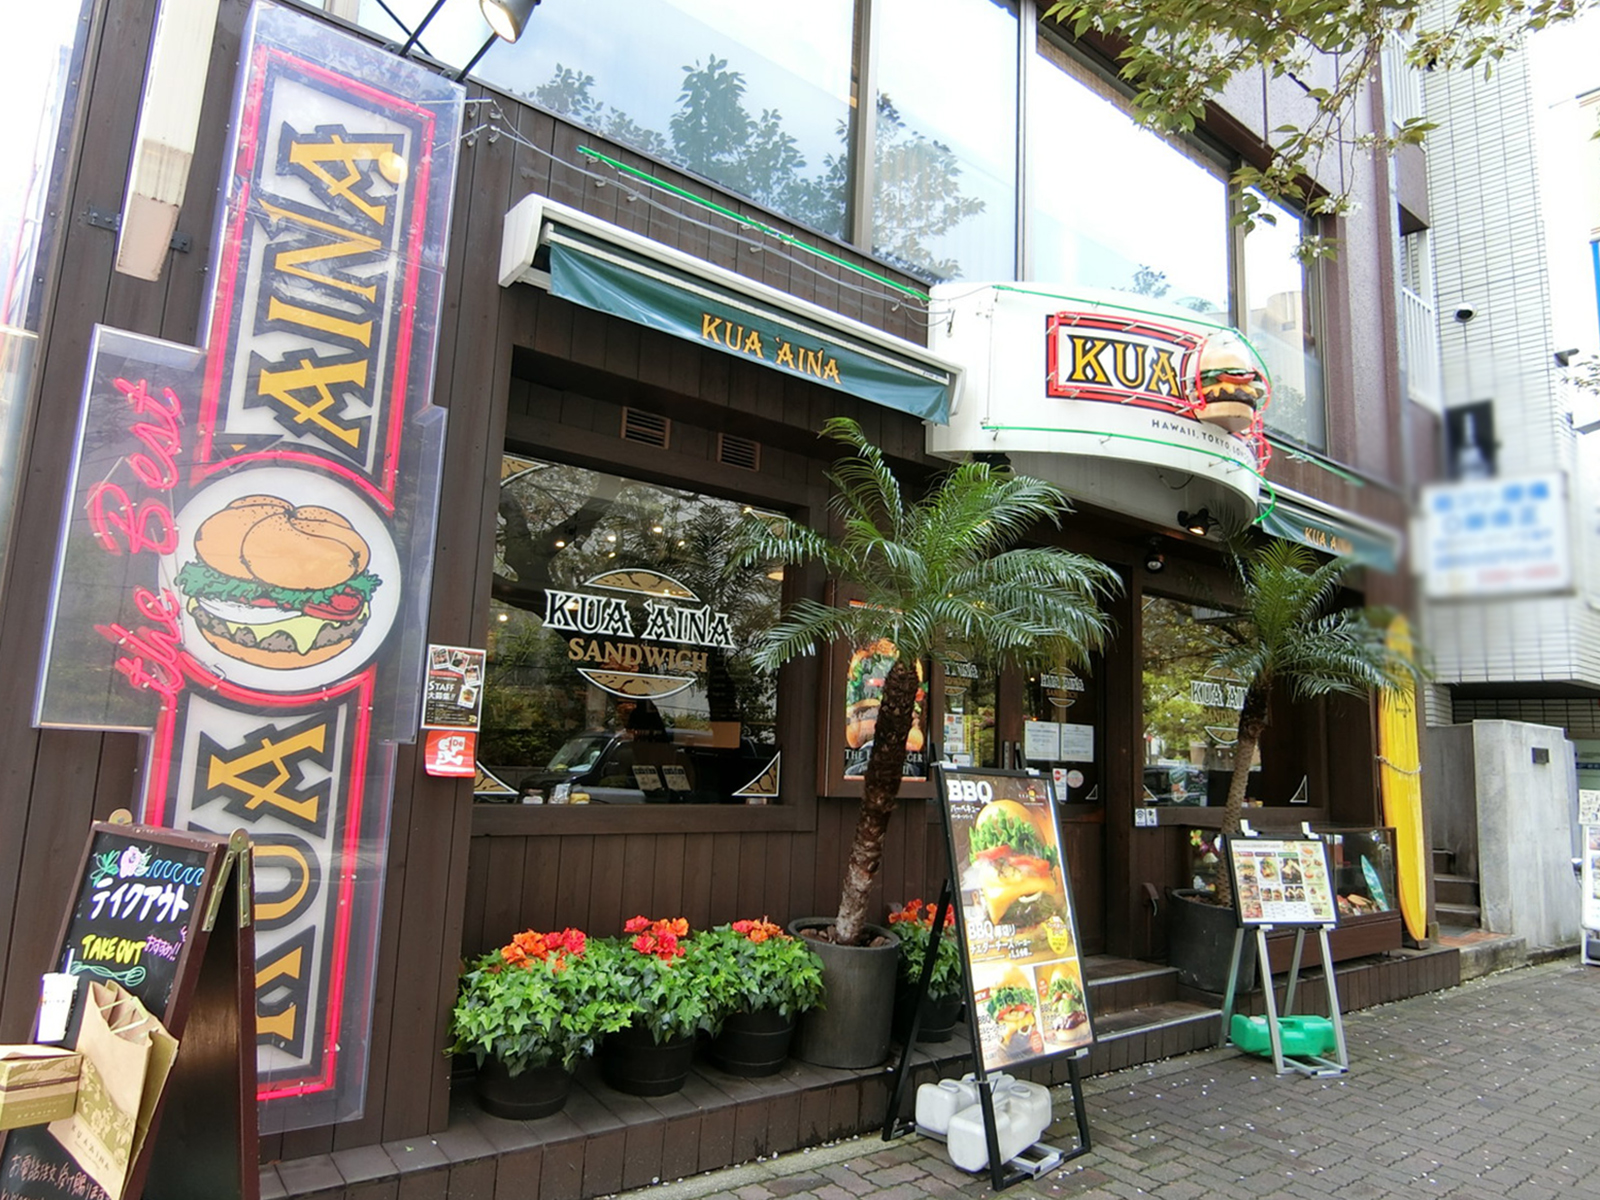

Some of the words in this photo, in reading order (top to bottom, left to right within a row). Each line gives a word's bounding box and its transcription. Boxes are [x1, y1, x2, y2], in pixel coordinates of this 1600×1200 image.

[701, 313, 764, 359] KUA
[1066, 334, 1183, 399] KUA
[1304, 527, 1326, 548] KUA
[543, 589, 634, 637] KUA
[568, 637, 708, 673] SANDWICH
[428, 681, 455, 692] STAFF
[1190, 680, 1224, 707] KUA
[844, 749, 863, 760] THE
[946, 779, 993, 805] BBQ
[89, 877, 190, 923] テイクアウト
[967, 920, 994, 941] BBQ
[81, 935, 116, 961] TAKE
[117, 939, 146, 966] OUT
